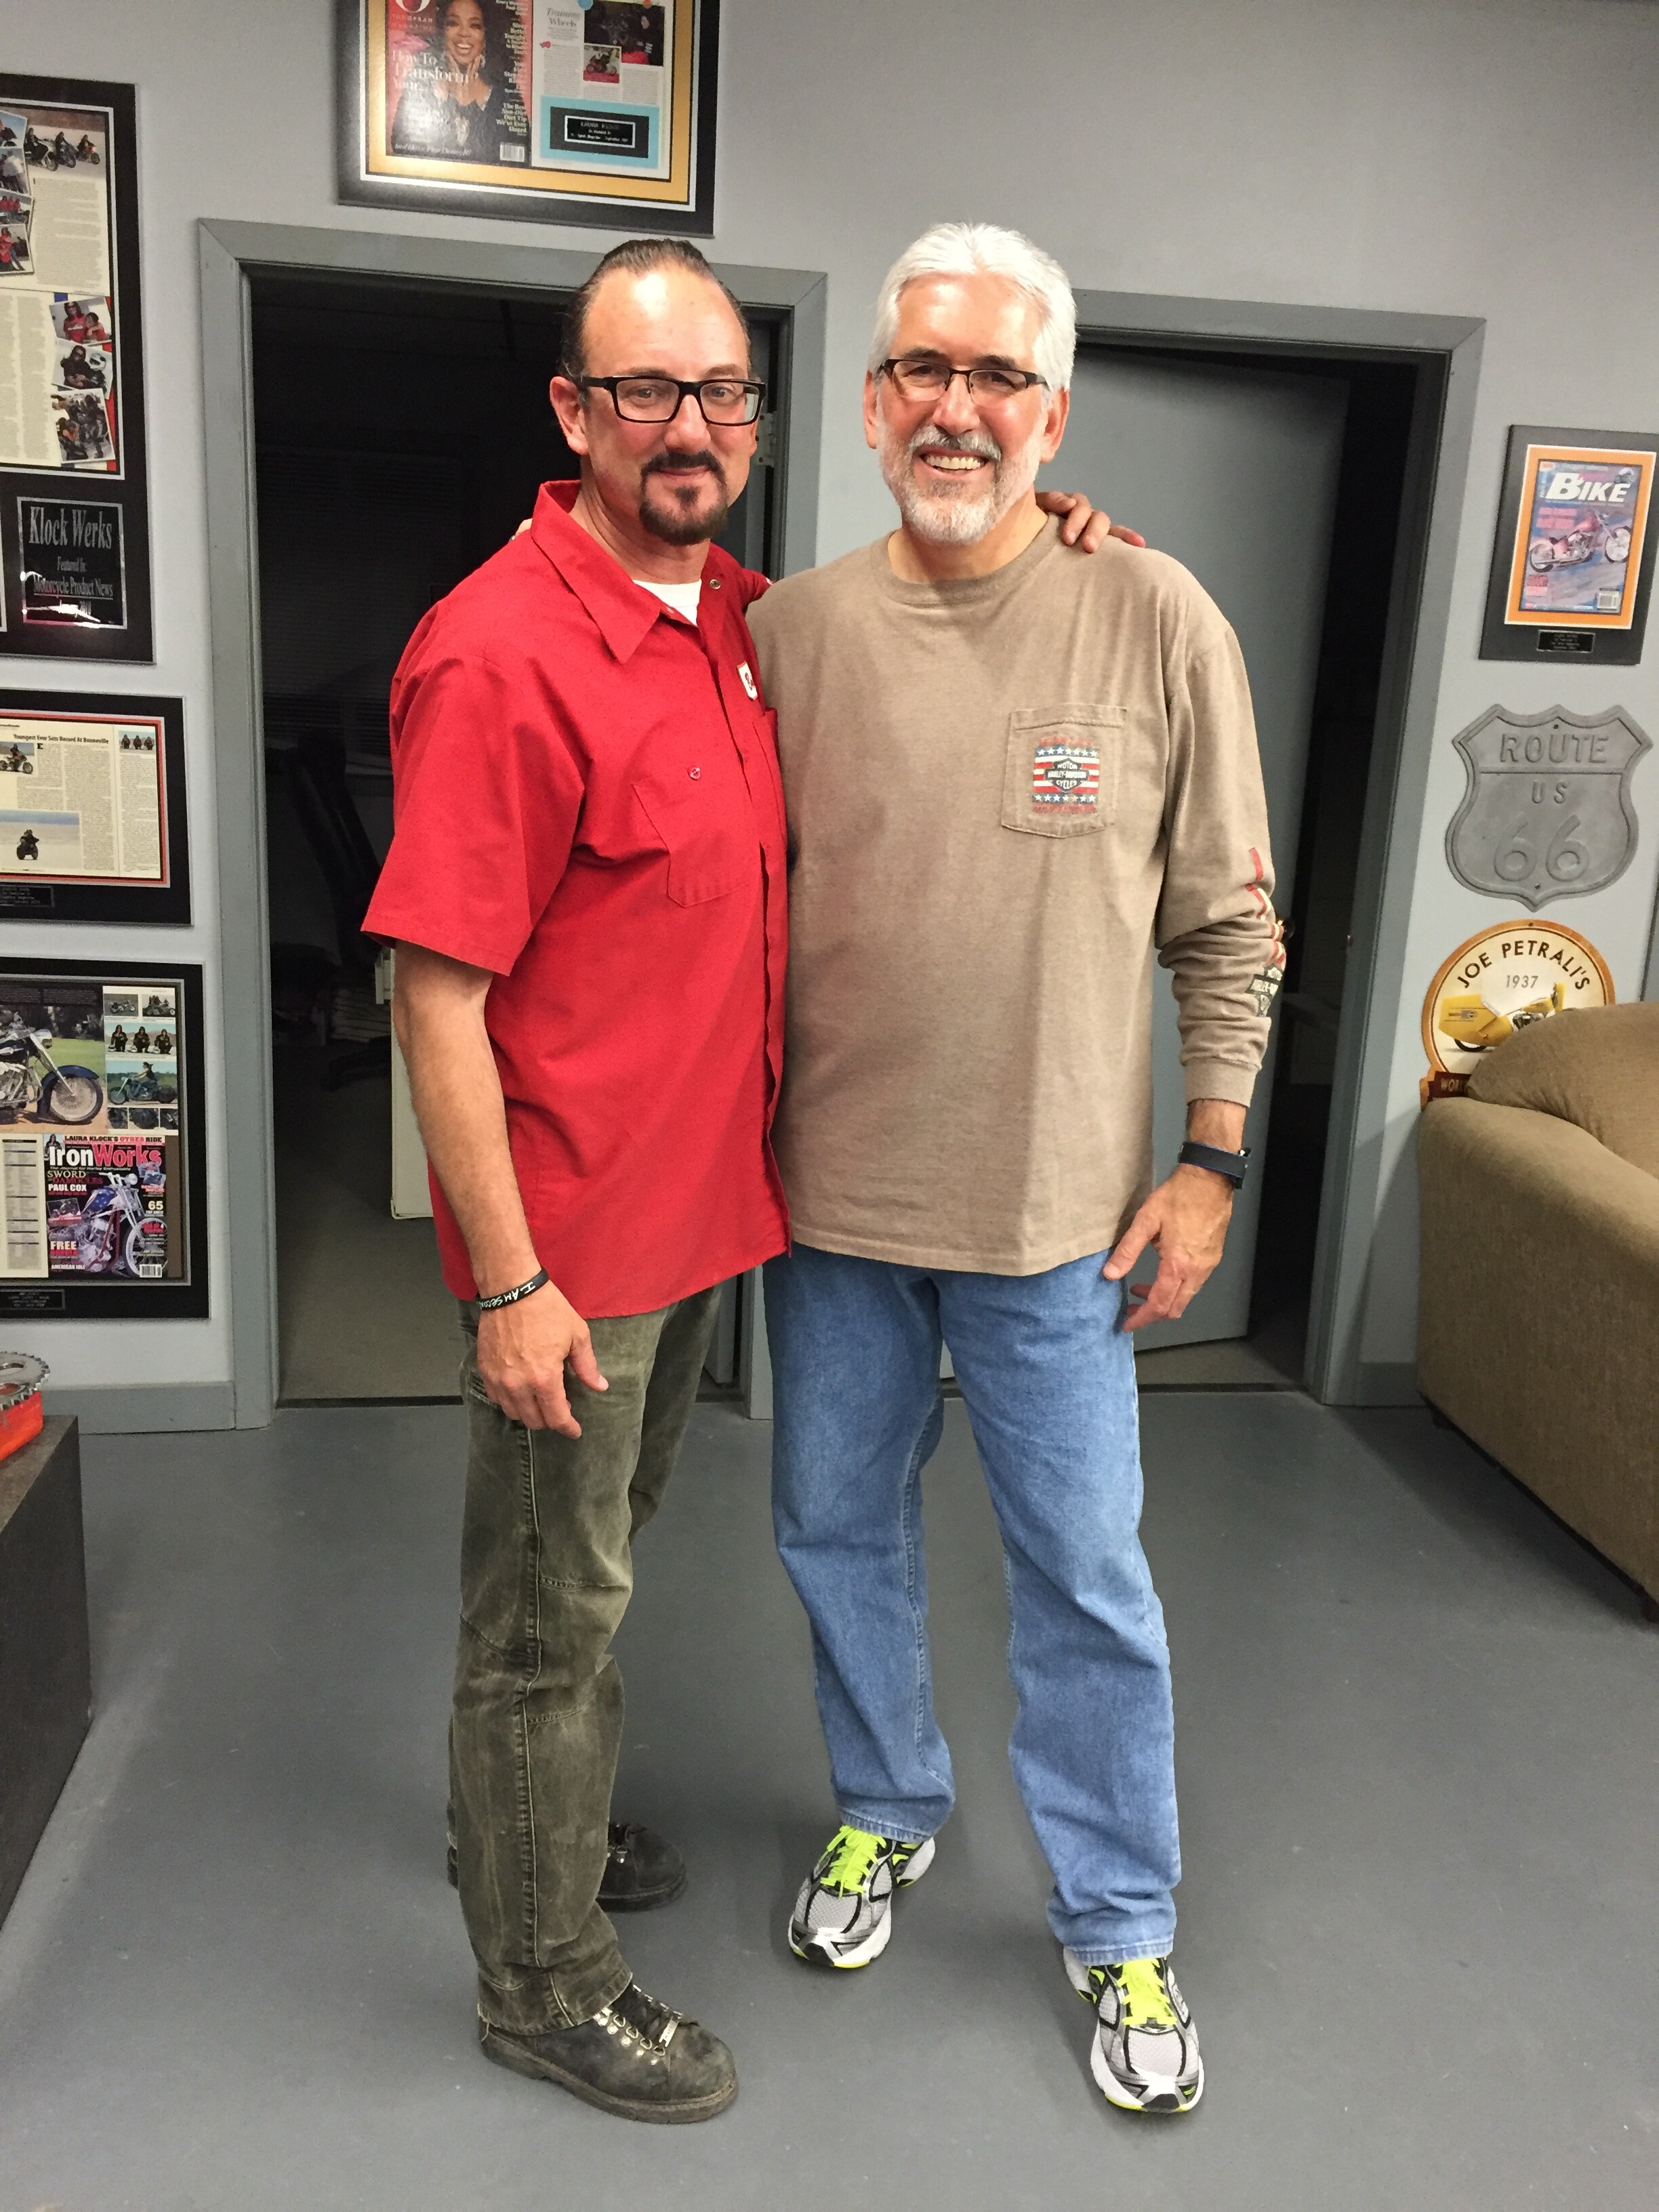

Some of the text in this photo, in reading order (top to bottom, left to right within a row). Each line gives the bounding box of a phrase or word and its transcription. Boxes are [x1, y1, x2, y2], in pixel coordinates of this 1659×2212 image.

[29, 506, 112, 549] Klock Werks
[70, 576, 94, 596] Product
[95, 578, 113, 596] News
[1499, 733, 1610, 764] ROUTE
[1057, 760, 1078, 770] MOTOR
[1056, 779, 1078, 790] CYCLES
[1494, 813, 1590, 882] 66
[1457, 940, 1591, 990] JOE PETRALI'S
[1505, 975, 1539, 989] 1937
[47, 1170, 87, 1179] SWORD
[48, 1184, 87, 1192] PAUL COX
[148, 1200, 164, 1210] 65
[51, 1241, 77, 1250] FREE
[504, 1288, 519, 1303] AM
